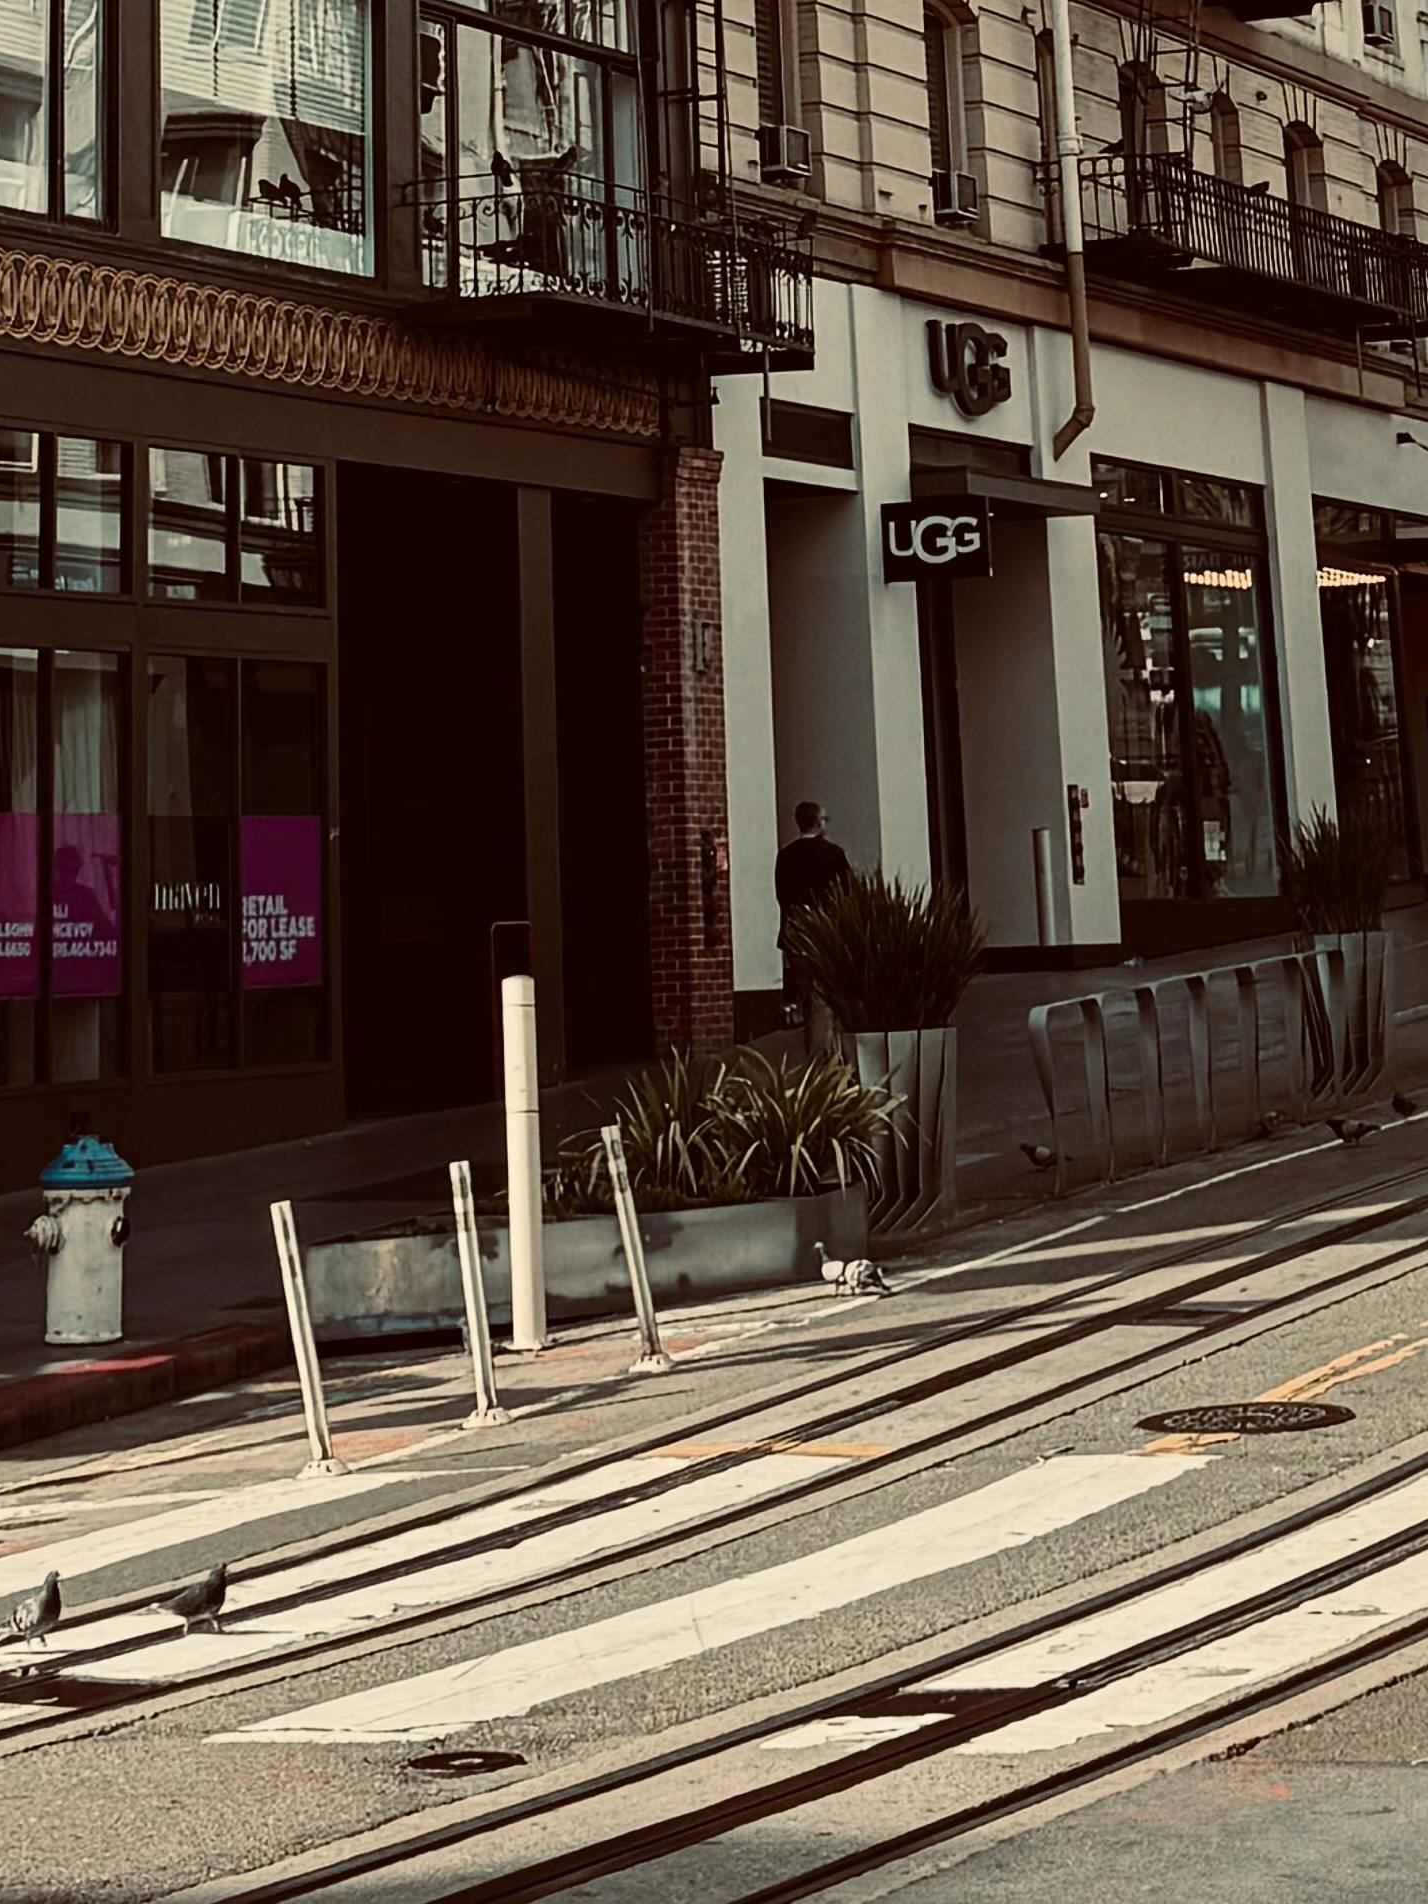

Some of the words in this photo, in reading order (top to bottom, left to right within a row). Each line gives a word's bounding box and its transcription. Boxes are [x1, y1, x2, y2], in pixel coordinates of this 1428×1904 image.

[925, 319, 1013, 417] UGG
[888, 514, 982, 565] UGG
[154, 882, 221, 912] maven
[271, 916, 316, 939] LEASE
[279, 940, 298, 962] SF
